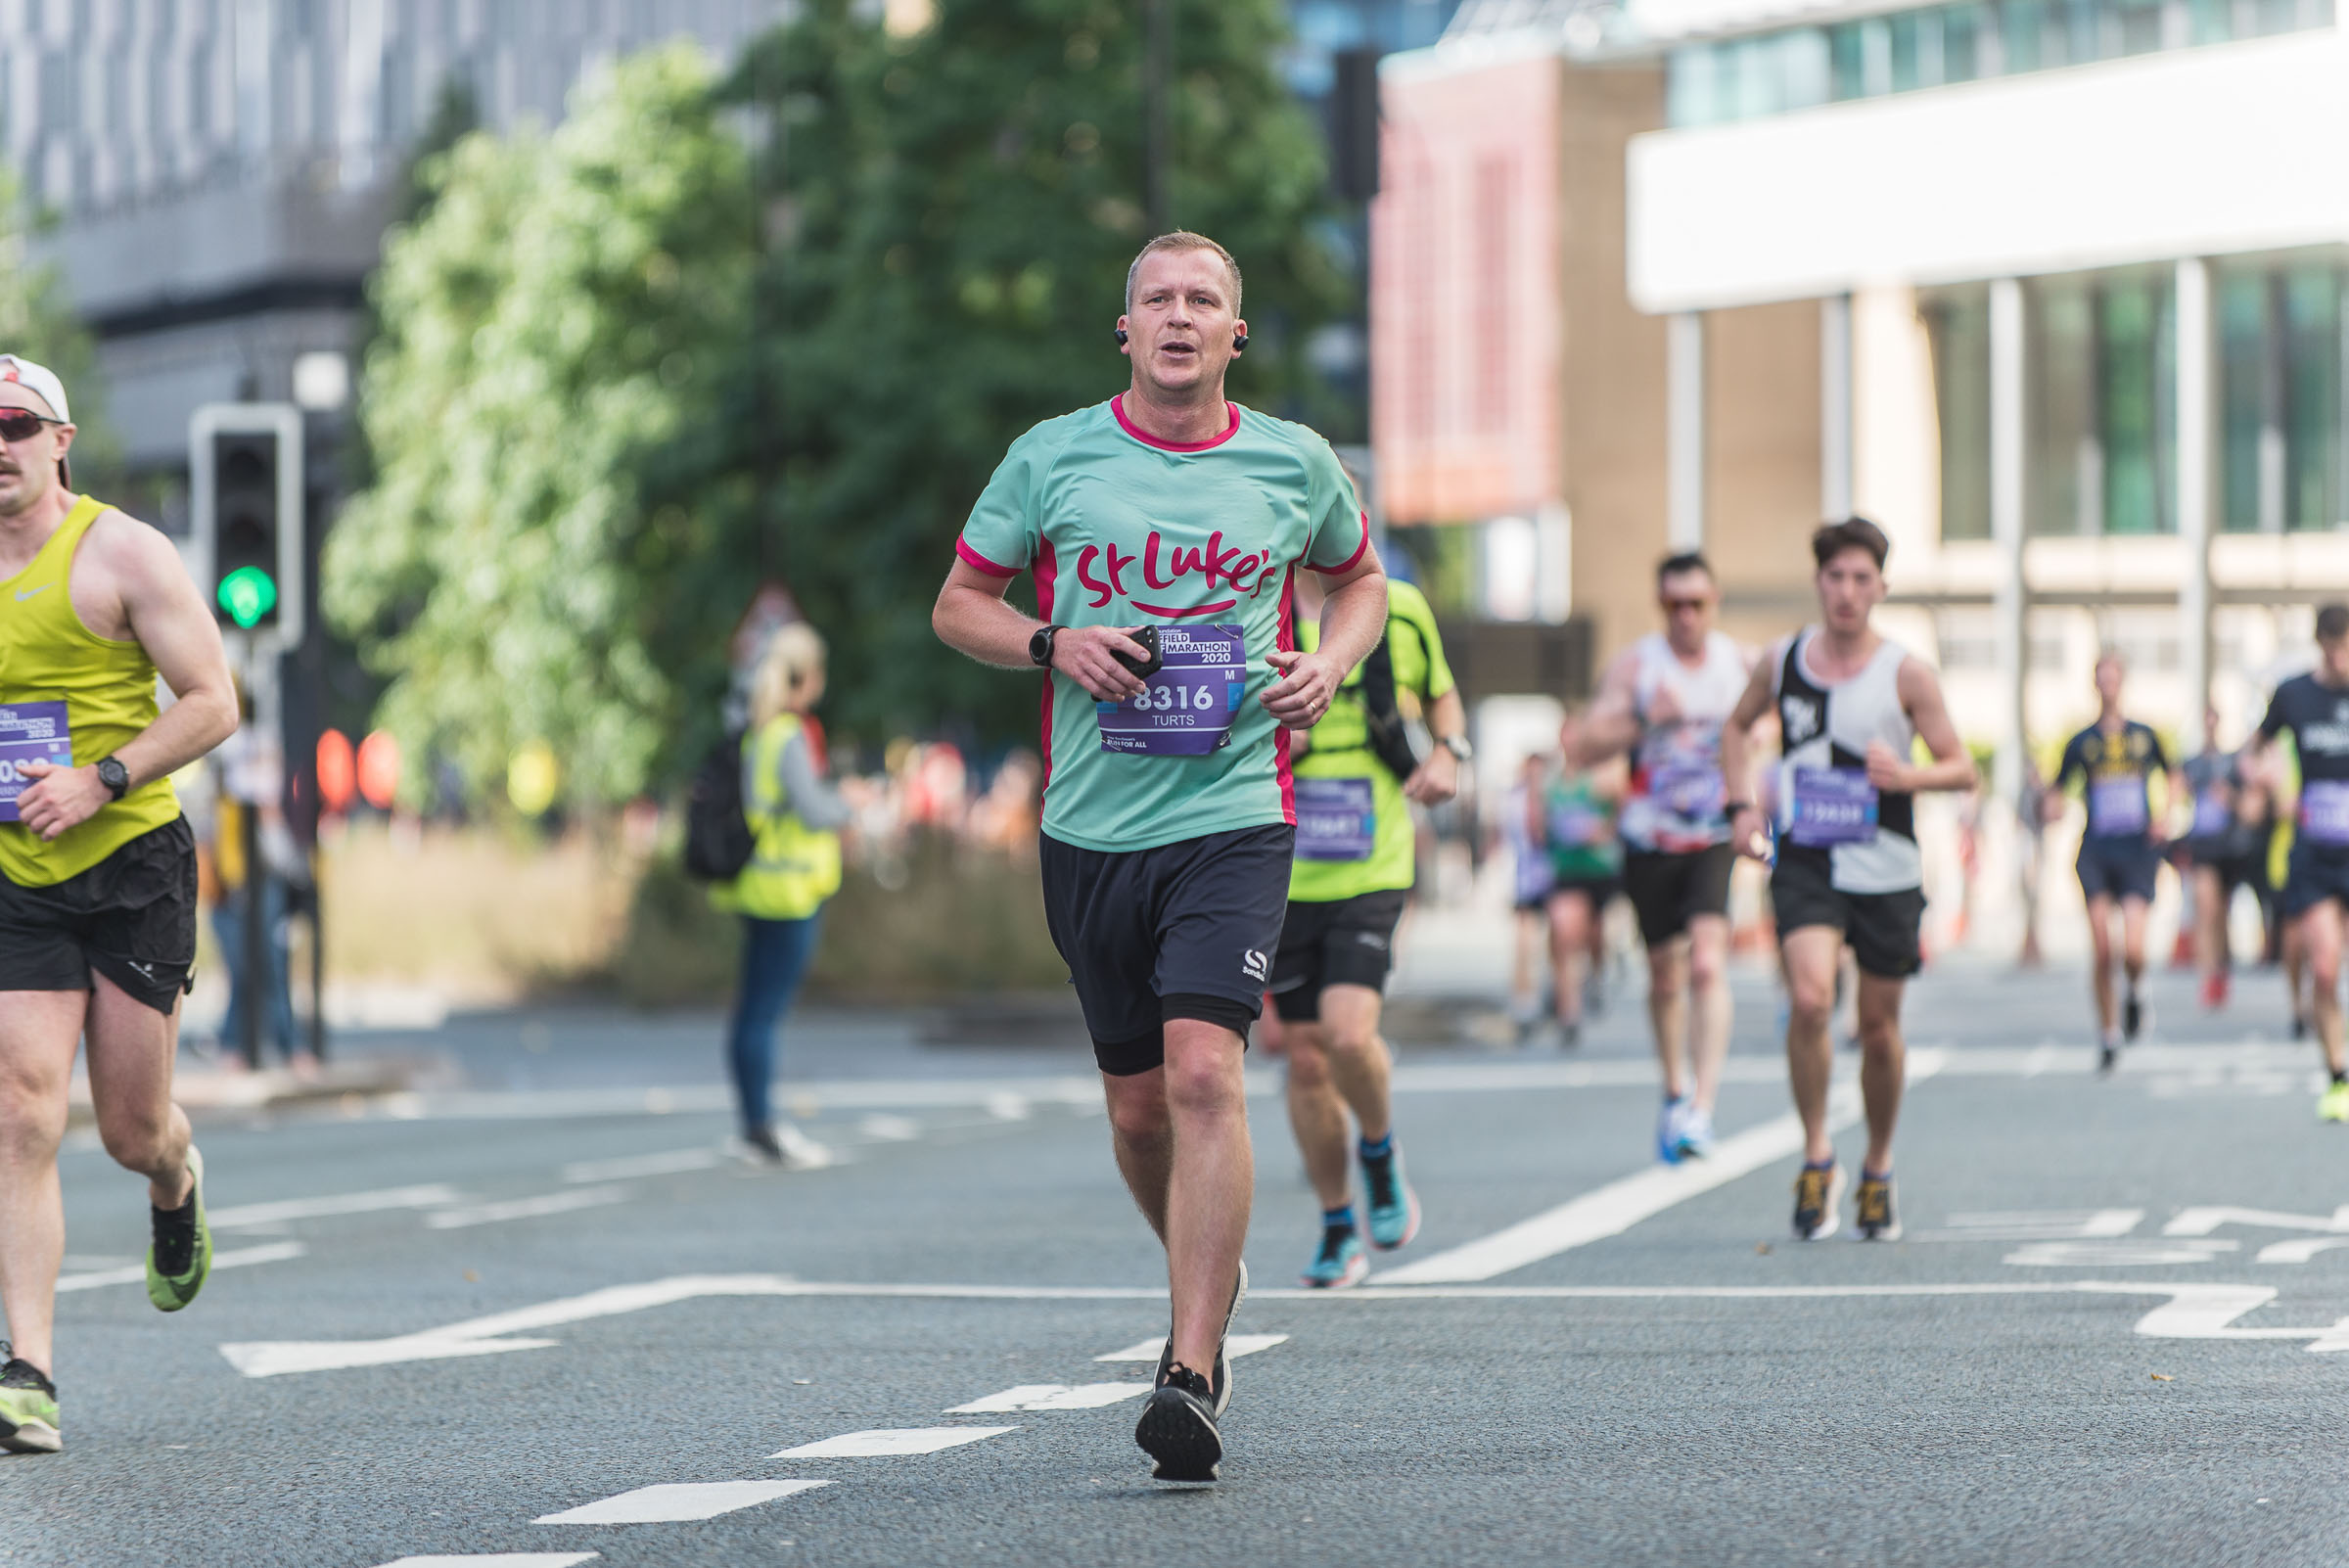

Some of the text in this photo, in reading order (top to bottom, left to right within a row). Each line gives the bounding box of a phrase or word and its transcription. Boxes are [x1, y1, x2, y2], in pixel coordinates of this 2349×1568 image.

[1143, 530, 1275, 599] Luke's
[1168, 643, 1229, 652] MARATHON
[1201, 653, 1231, 663] 2020
[1224, 669, 1235, 680] M
[1133, 685, 1213, 711] 8316
[1152, 715, 1195, 726] TURTS
